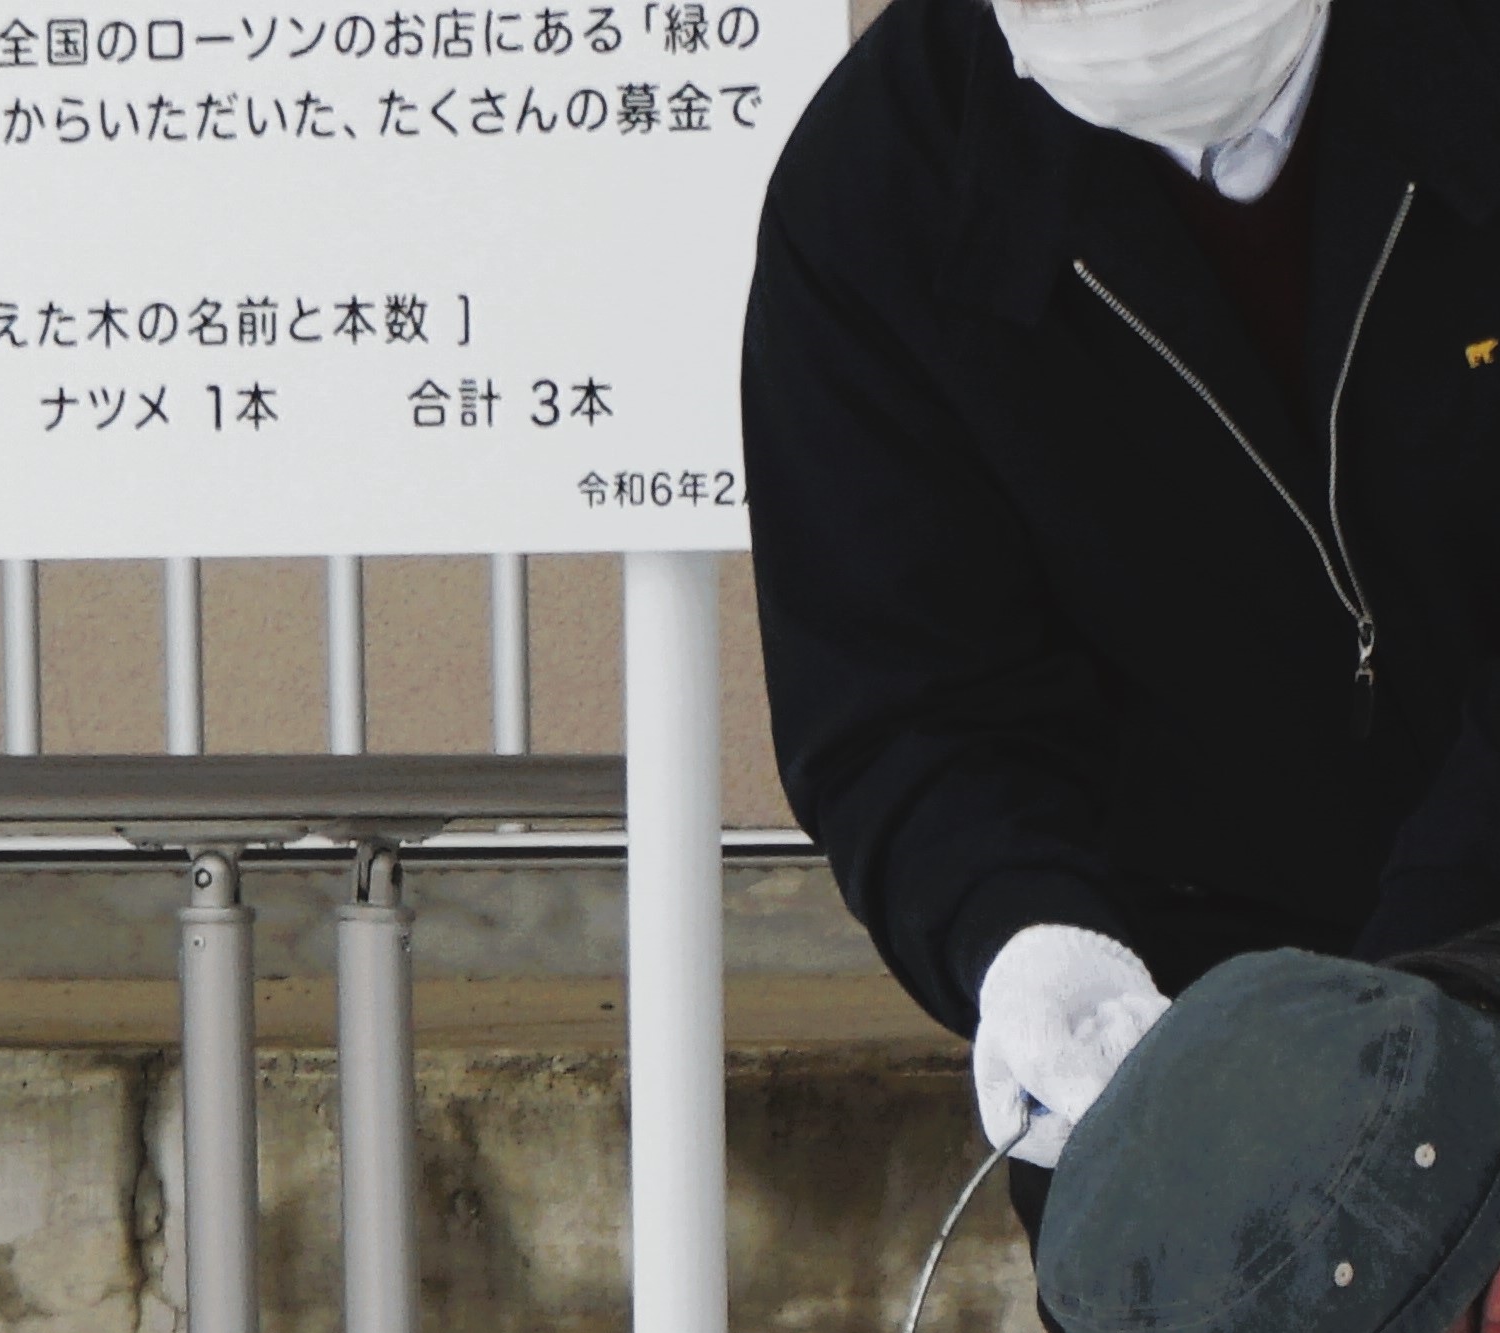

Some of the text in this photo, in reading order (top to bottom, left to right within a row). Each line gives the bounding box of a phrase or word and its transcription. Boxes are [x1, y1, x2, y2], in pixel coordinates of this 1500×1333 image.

[40, 384, 170, 431] ナツメ
[205, 382, 279, 430] 1本
[407, 378, 501, 428] 合計
[530, 376, 613, 428] 3本
[577, 469, 748, 508] 令和6年2
